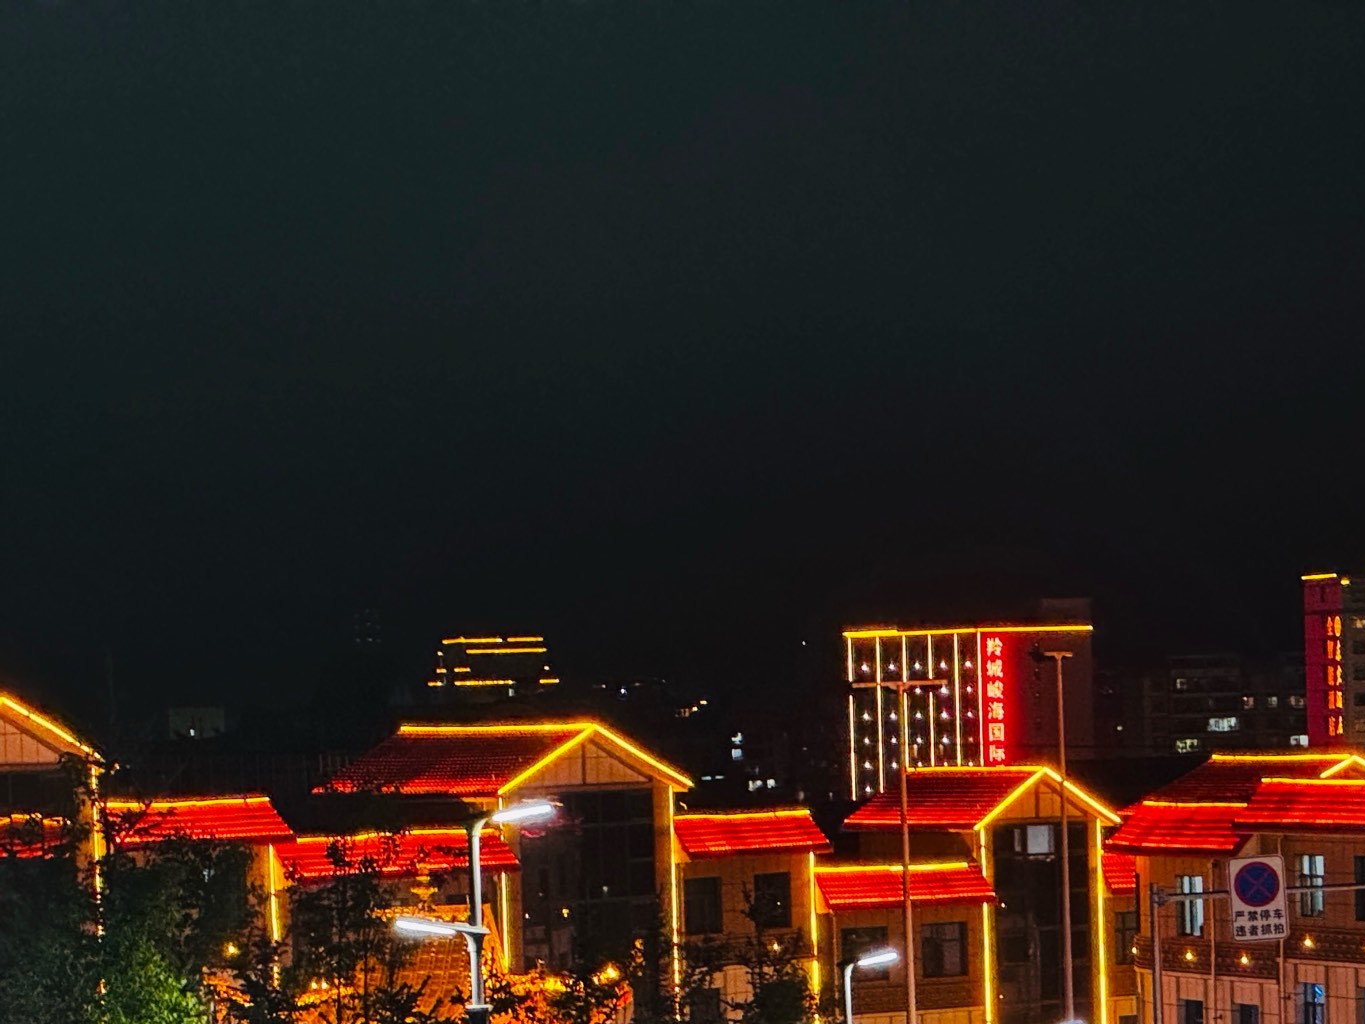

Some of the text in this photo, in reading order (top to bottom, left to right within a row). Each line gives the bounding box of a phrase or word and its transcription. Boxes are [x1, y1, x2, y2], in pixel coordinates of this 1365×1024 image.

[986, 637, 1005, 767] 羚城峻海国际
[1234, 909, 1284, 922] 严禁停车
[1235, 923, 1285, 937] 违者抓拍
